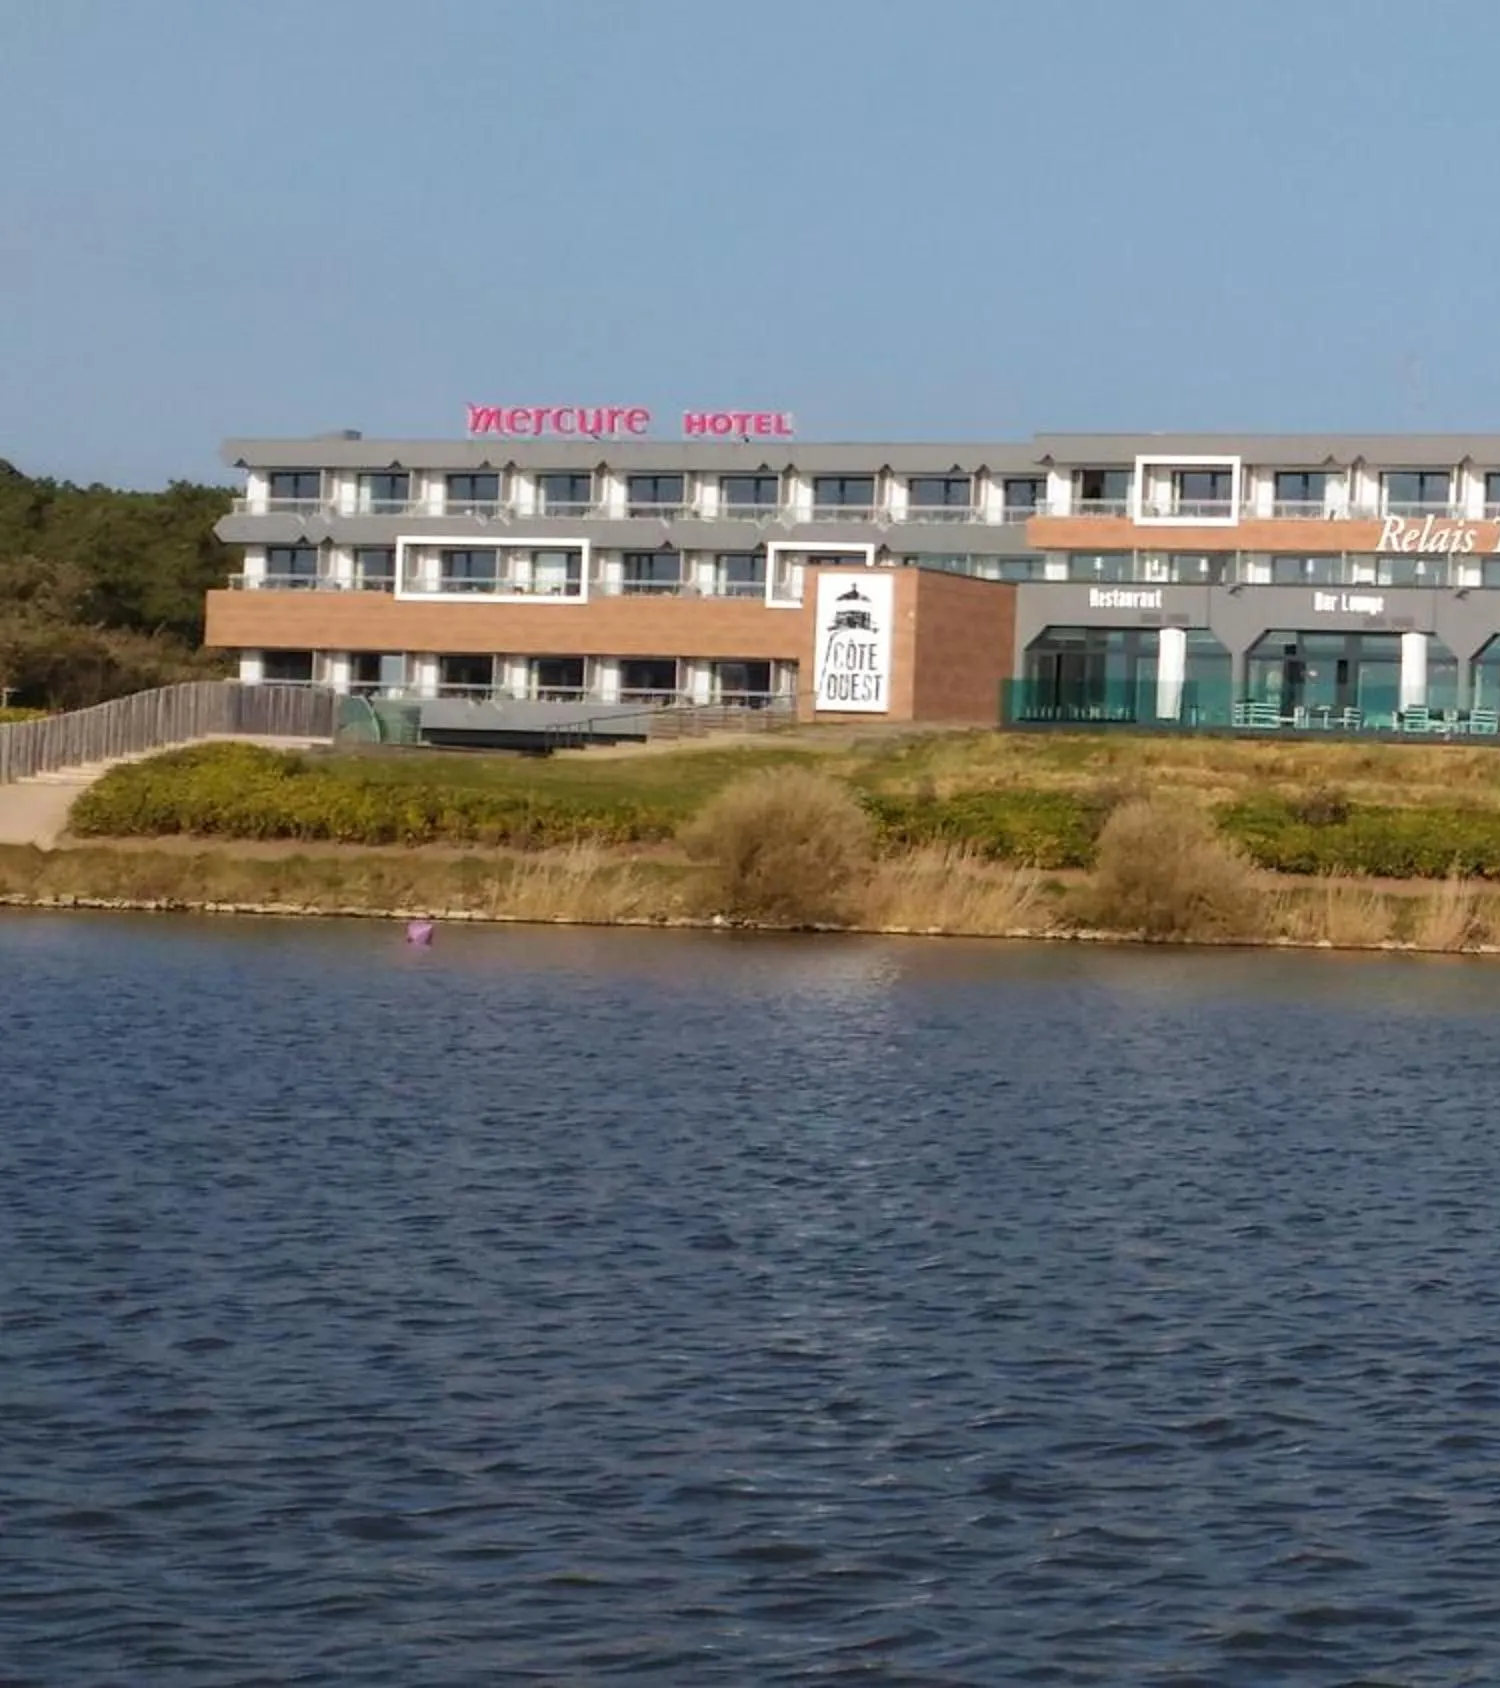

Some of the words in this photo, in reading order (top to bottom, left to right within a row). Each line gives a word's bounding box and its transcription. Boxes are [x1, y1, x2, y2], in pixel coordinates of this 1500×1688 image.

[467, 403, 650, 438] mercure
[684, 411, 793, 435] HOTEL
[1376, 515, 1477, 553] Relais
[833, 638, 878, 671] CÔTE
[827, 673, 883, 701] OUEST
